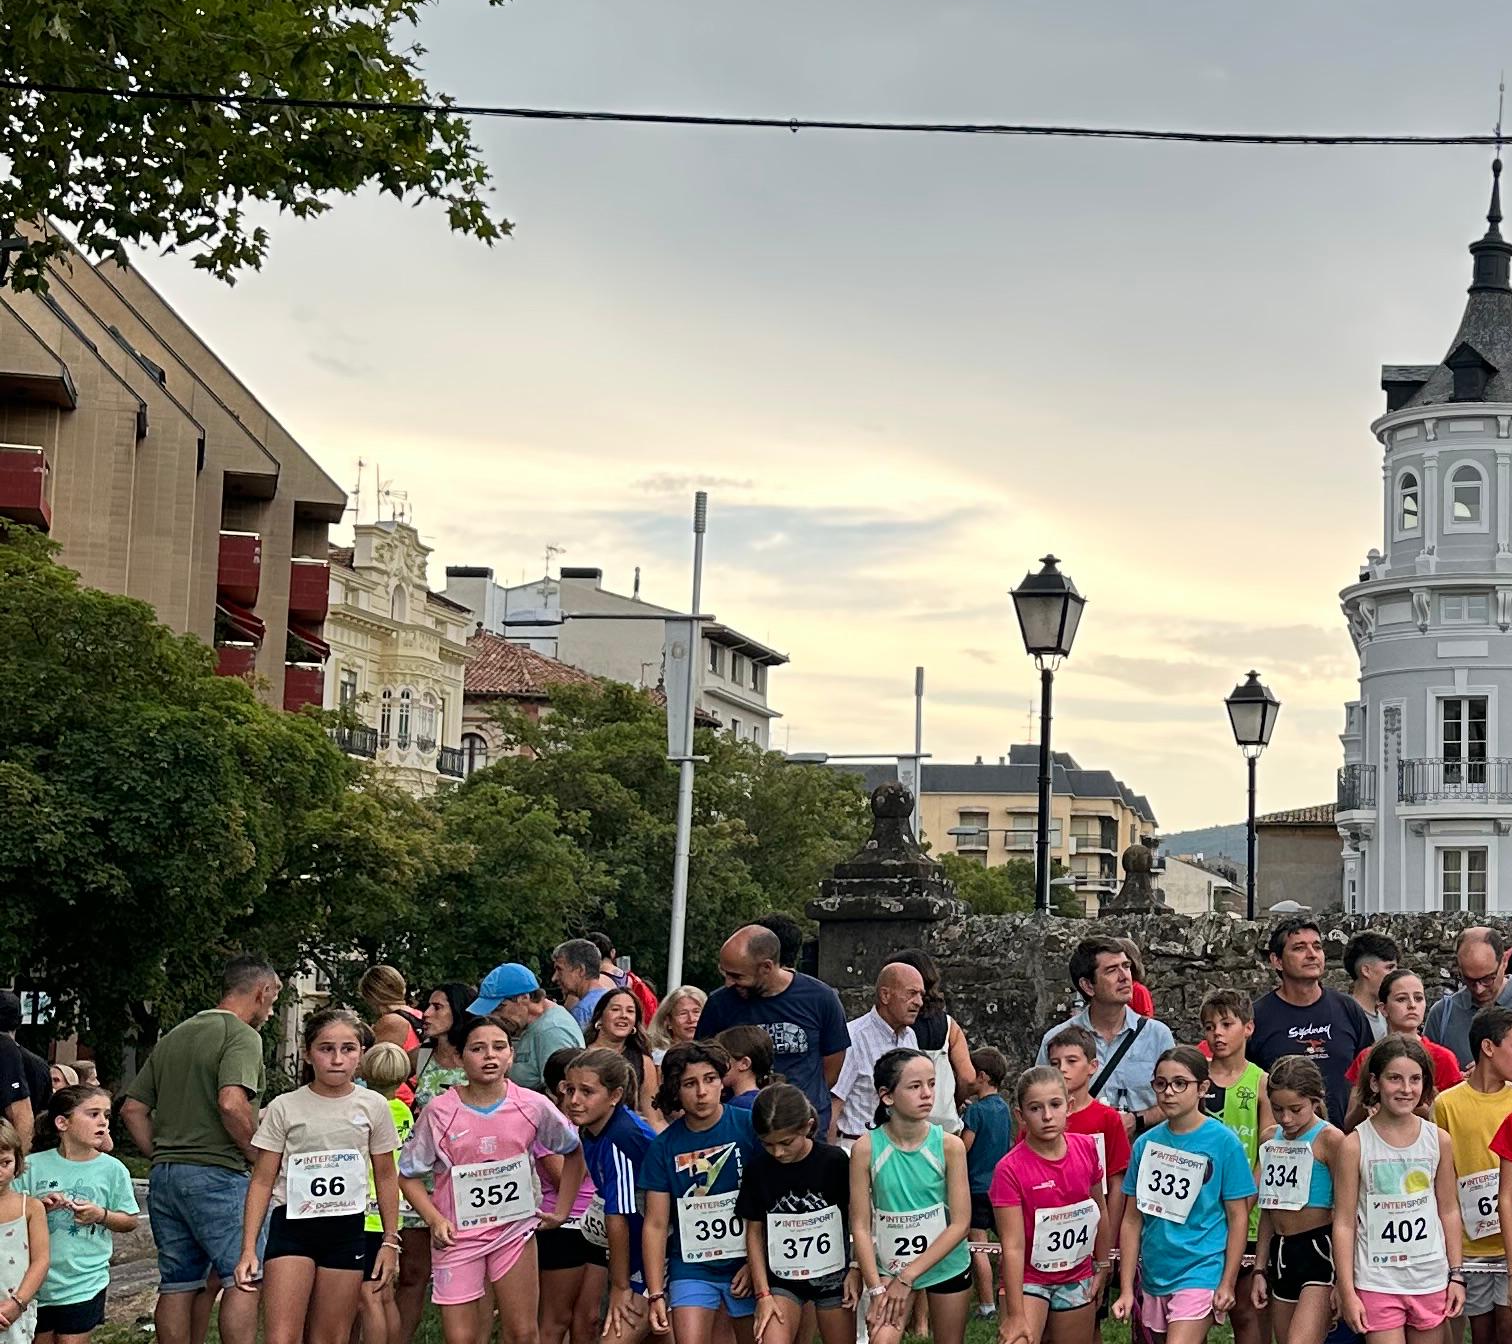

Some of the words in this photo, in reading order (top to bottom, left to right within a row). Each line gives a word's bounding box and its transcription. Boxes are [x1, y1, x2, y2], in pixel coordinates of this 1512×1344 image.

[1288, 1022, 1332, 1040] Sydney
[303, 1154, 360, 1165] INTERSPORT
[1268, 1146, 1308, 1155] INTERSPORT
[468, 1161, 522, 1177] INTERSPORT
[1157, 1151, 1204, 1170] INTERSPORT
[1148, 1169, 1191, 1200] 333
[1265, 1164, 1298, 1188] 334
[310, 1176, 345, 1197] 66
[470, 1181, 520, 1208] 352
[694, 1197, 736, 1210] INTERSPO
[1381, 1196, 1429, 1210] INTERSPORT
[782, 1212, 834, 1227] INTERSPORT
[886, 1208, 940, 1224] INTERSPORT
[1050, 1205, 1094, 1222] INTERSPORT
[695, 1215, 744, 1241] 390
[1381, 1217, 1427, 1243] 402
[783, 1233, 831, 1260] 376
[894, 1235, 928, 1256] 29
[1047, 1225, 1088, 1252] 304
